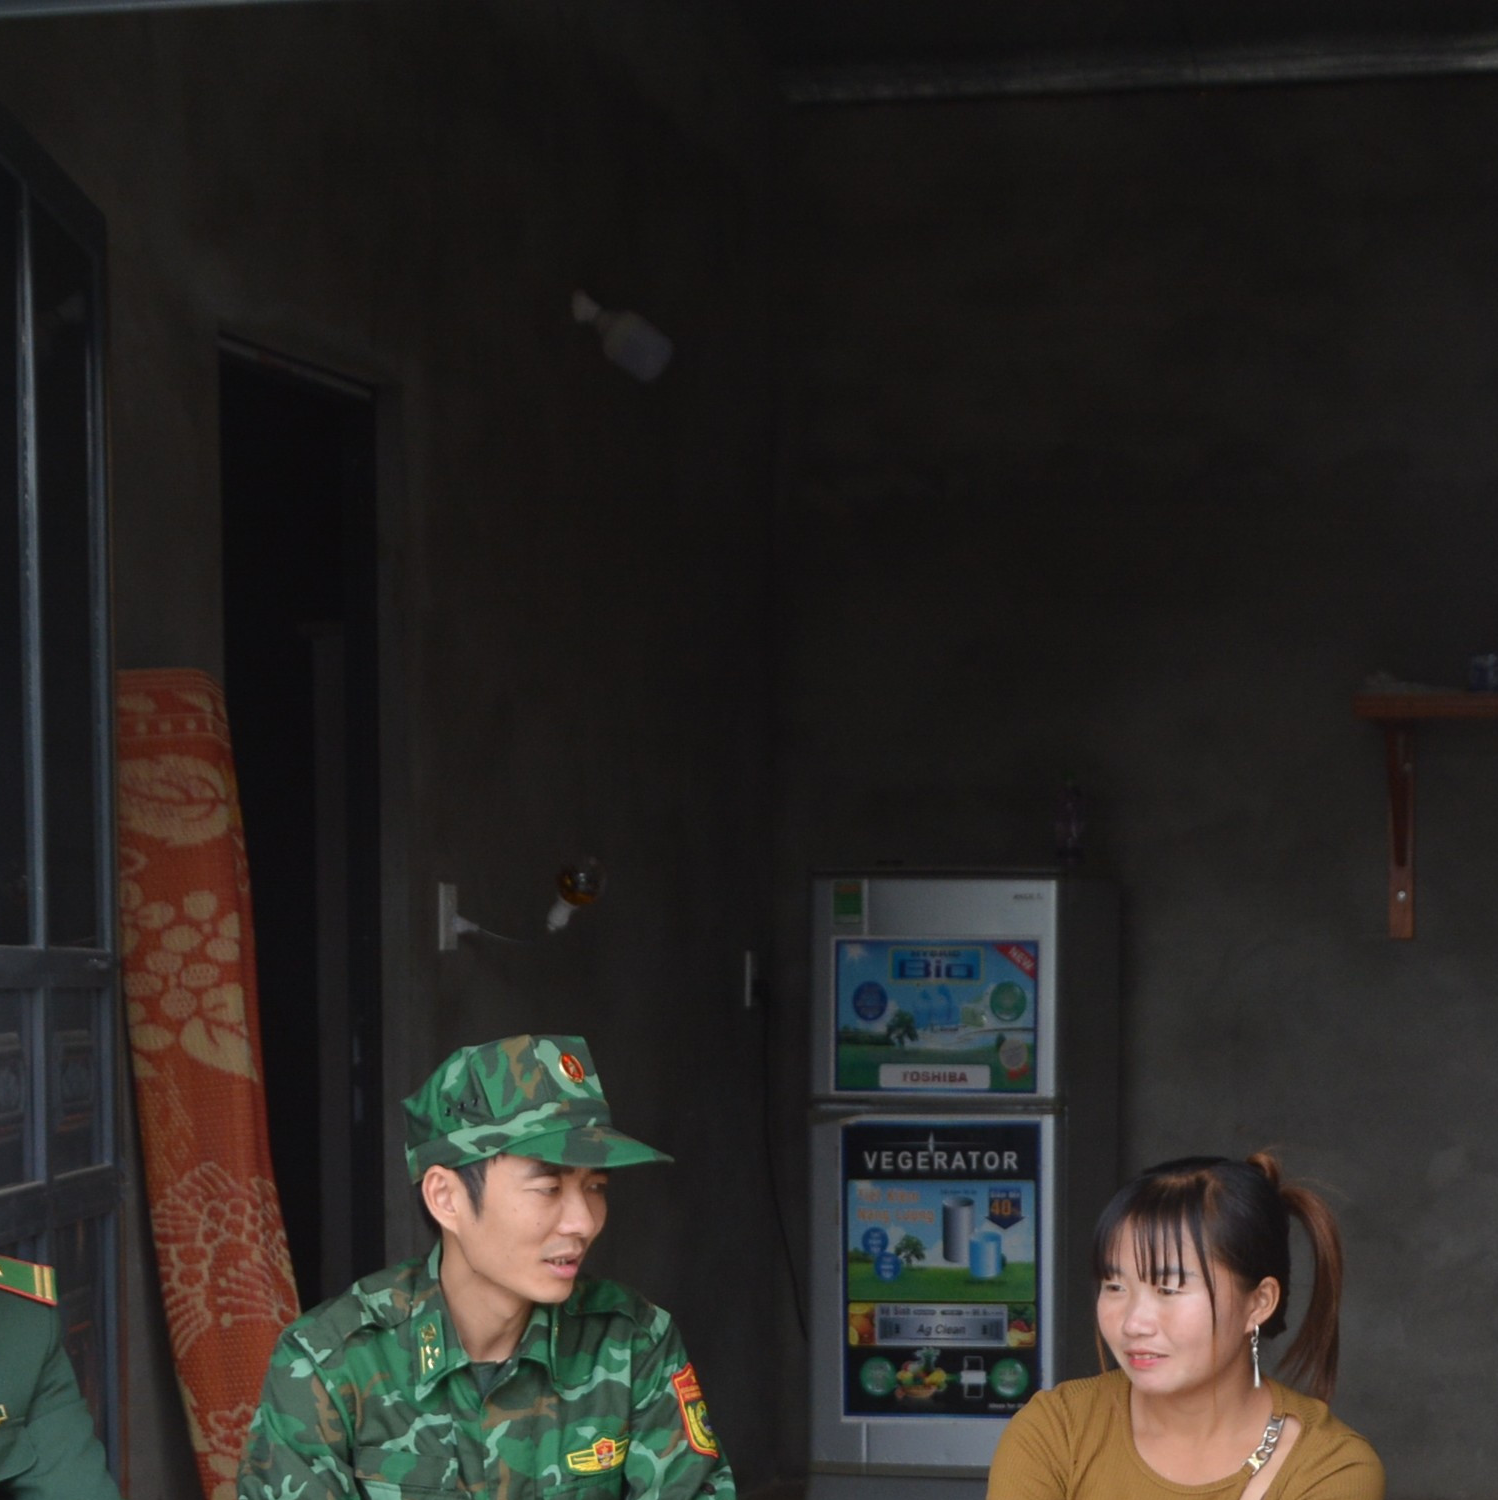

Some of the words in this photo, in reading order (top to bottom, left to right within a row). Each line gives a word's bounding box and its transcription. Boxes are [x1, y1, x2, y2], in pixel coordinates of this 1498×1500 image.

[1008, 946, 1036, 970] NEW
[899, 958, 973, 979] Bio
[901, 1070, 968, 1083] TOSHIBA
[863, 1151, 1018, 1170] VEGERATOR
[935, 1323, 966, 1335] Clean
